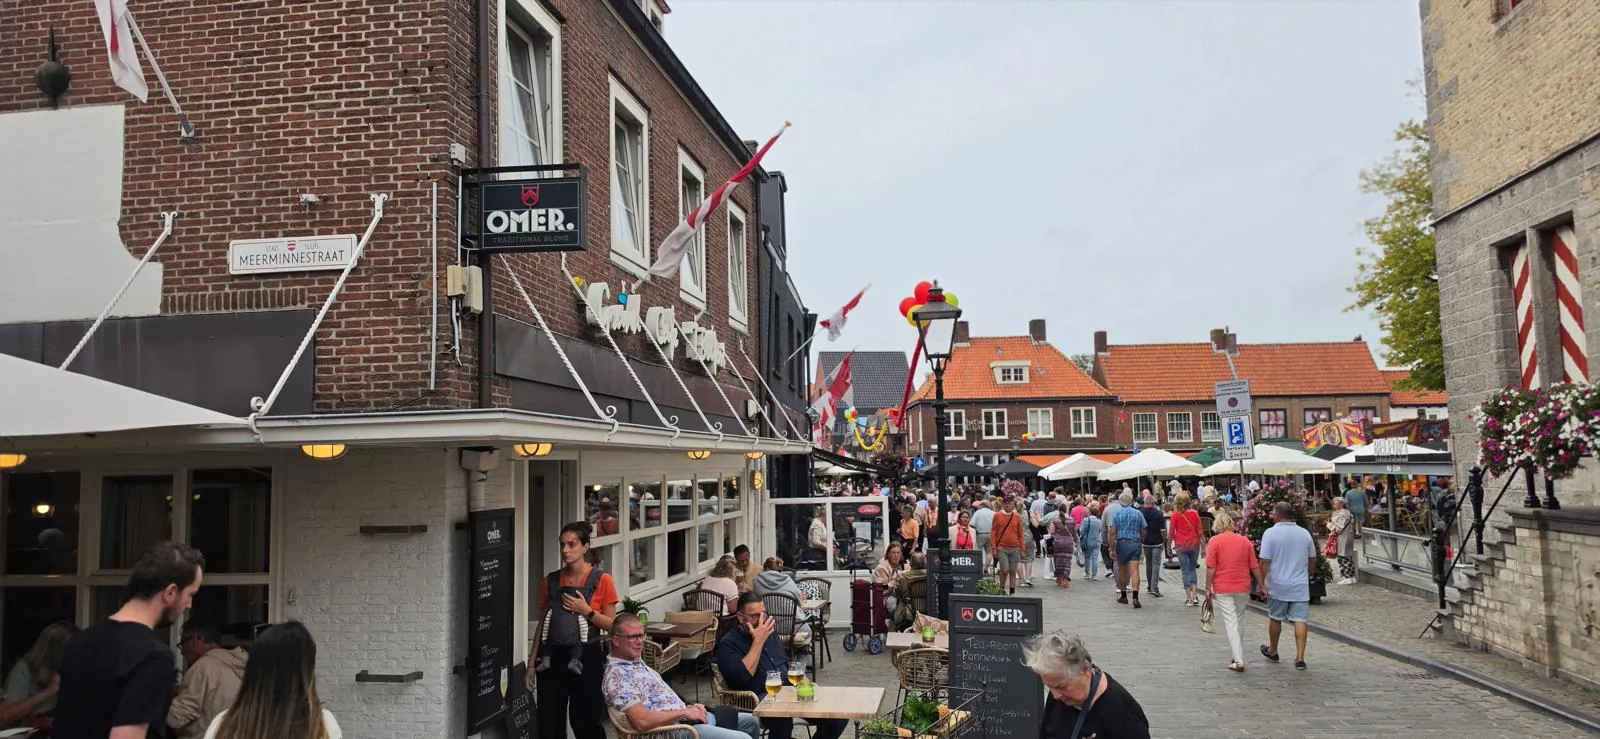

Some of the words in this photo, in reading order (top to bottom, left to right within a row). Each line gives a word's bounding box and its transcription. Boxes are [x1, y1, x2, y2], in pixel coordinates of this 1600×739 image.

[486, 208, 575, 234] OMER.
[493, 236, 541, 244] TRADITIONAL
[544, 234, 569, 242] BLOND
[239, 250, 345, 267] MEERMINNESTRAAT
[1231, 423, 1241, 436] P
[950, 556, 975, 566] MER.
[976, 607, 1029, 624] OMER.
